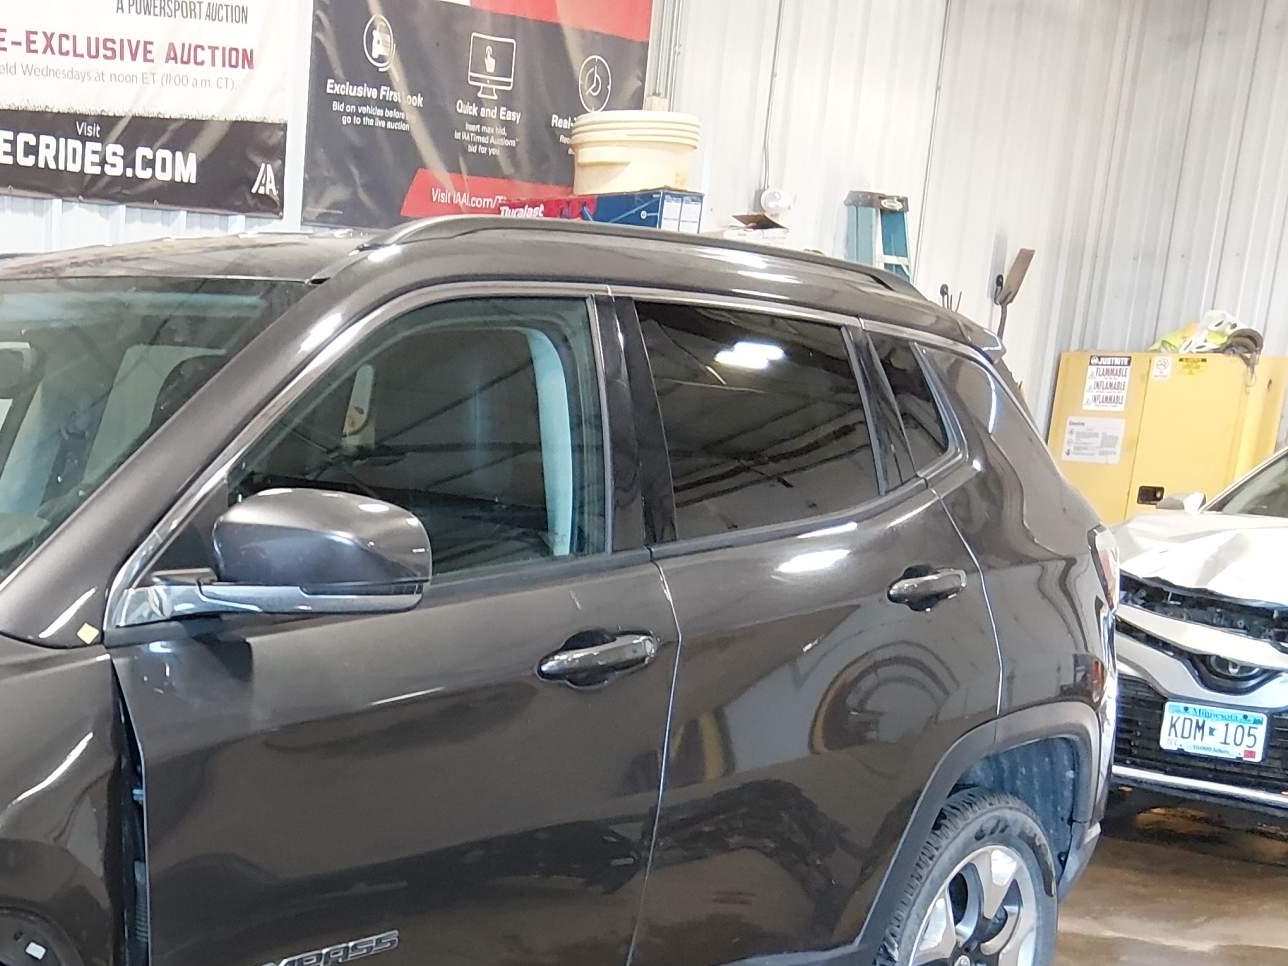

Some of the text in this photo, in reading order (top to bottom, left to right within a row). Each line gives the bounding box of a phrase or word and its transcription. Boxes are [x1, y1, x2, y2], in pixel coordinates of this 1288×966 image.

[116, 0, 249, 24] A POWERSPORT AUCTION
[164, 41, 255, 70] AUCTION
[20, 63, 92, 84] Wednesdays
[94, 72, 106, 83] at
[110, 72, 138, 86] noon
[141, 72, 157, 86] ET
[326, 78, 378, 99] Exclusive
[404, 93, 424, 108] ook
[332, 100, 345, 112] Bid
[345, 104, 356, 113] on
[357, 104, 384, 117] vehicles
[384, 107, 405, 119] before
[456, 99, 521, 124] Quick and Easy
[75, 120, 101, 138] Visit
[341, 115, 410, 132] go to the live auction
[431, 187, 451, 203] Visit
[1095, 367, 1129, 378] FLAMMABLE
[1093, 380, 1127, 391] INFLAMABLE
[1193, 707, 1238, 721] Minnesota
[1168, 715, 1258, 749] KDM 105
